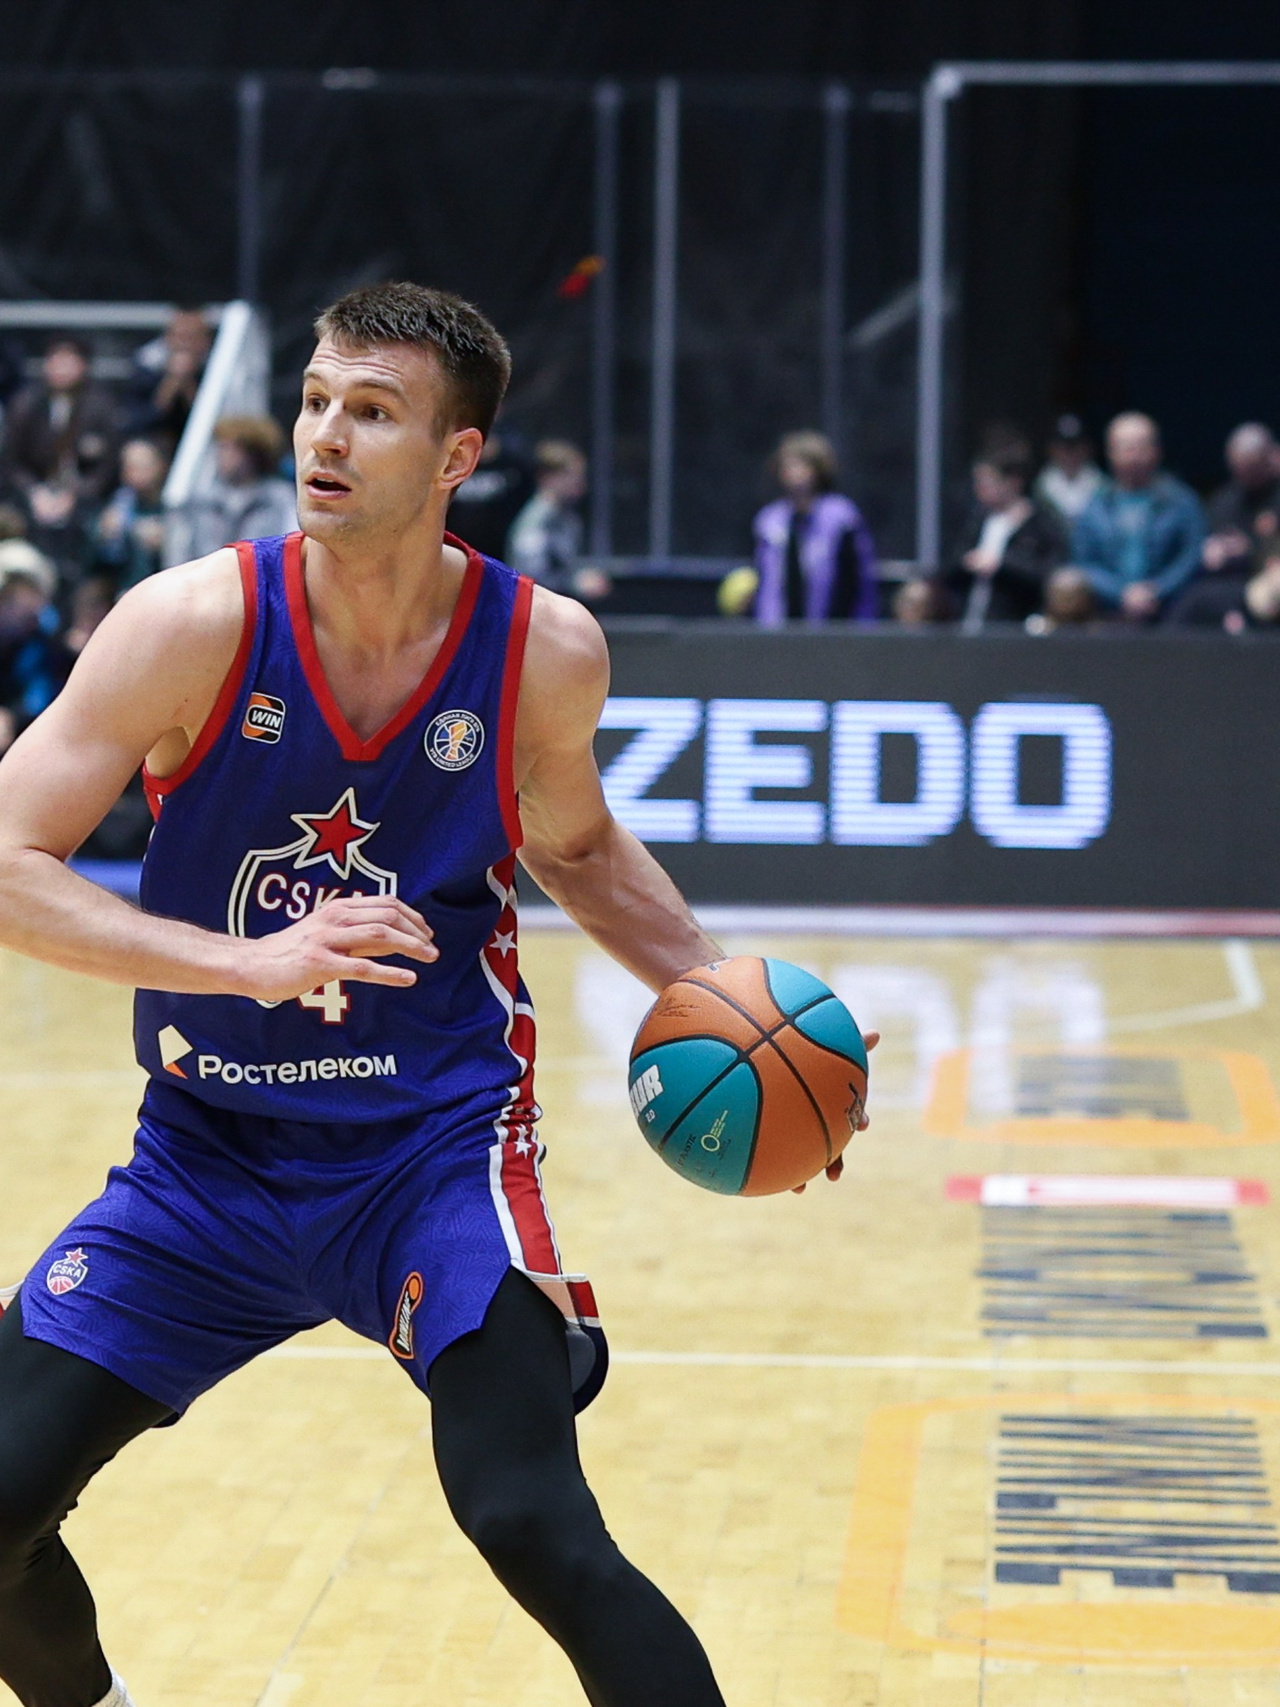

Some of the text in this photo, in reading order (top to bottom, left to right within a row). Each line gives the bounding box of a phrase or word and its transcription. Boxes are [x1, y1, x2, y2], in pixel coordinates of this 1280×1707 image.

[251, 710, 282, 728] WIN
[257, 873, 364, 920] CSK
[197, 1054, 397, 1085] Ростелеком
[629, 1064, 664, 1119] UR
[53, 1264, 82, 1278] CSKA
